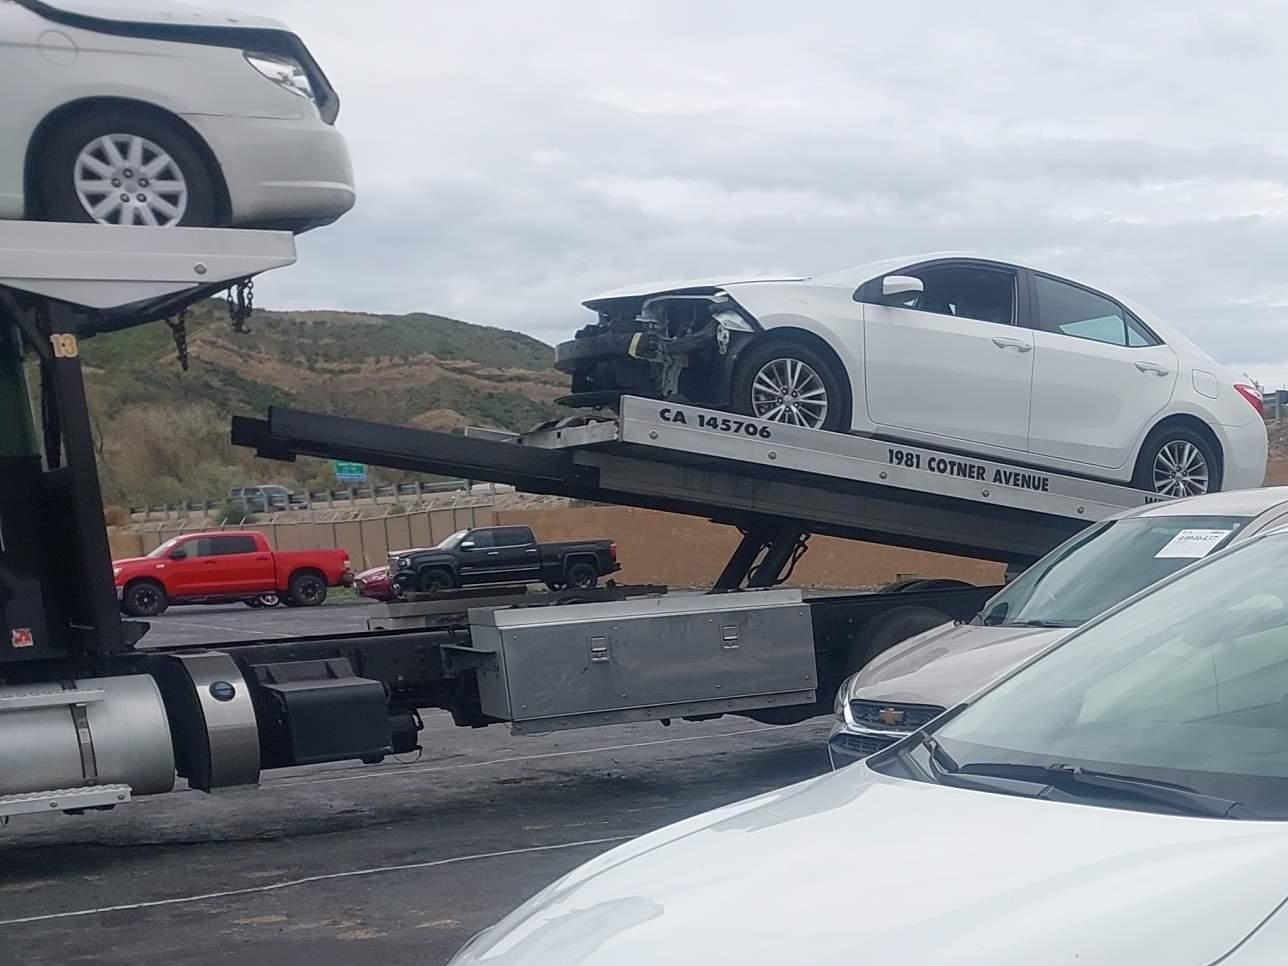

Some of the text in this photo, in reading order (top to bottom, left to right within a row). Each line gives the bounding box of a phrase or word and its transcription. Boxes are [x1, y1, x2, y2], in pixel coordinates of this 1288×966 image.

[660, 408, 771, 438] CA 145706
[888, 448, 1049, 492] 1981 COTNER AVENUE
